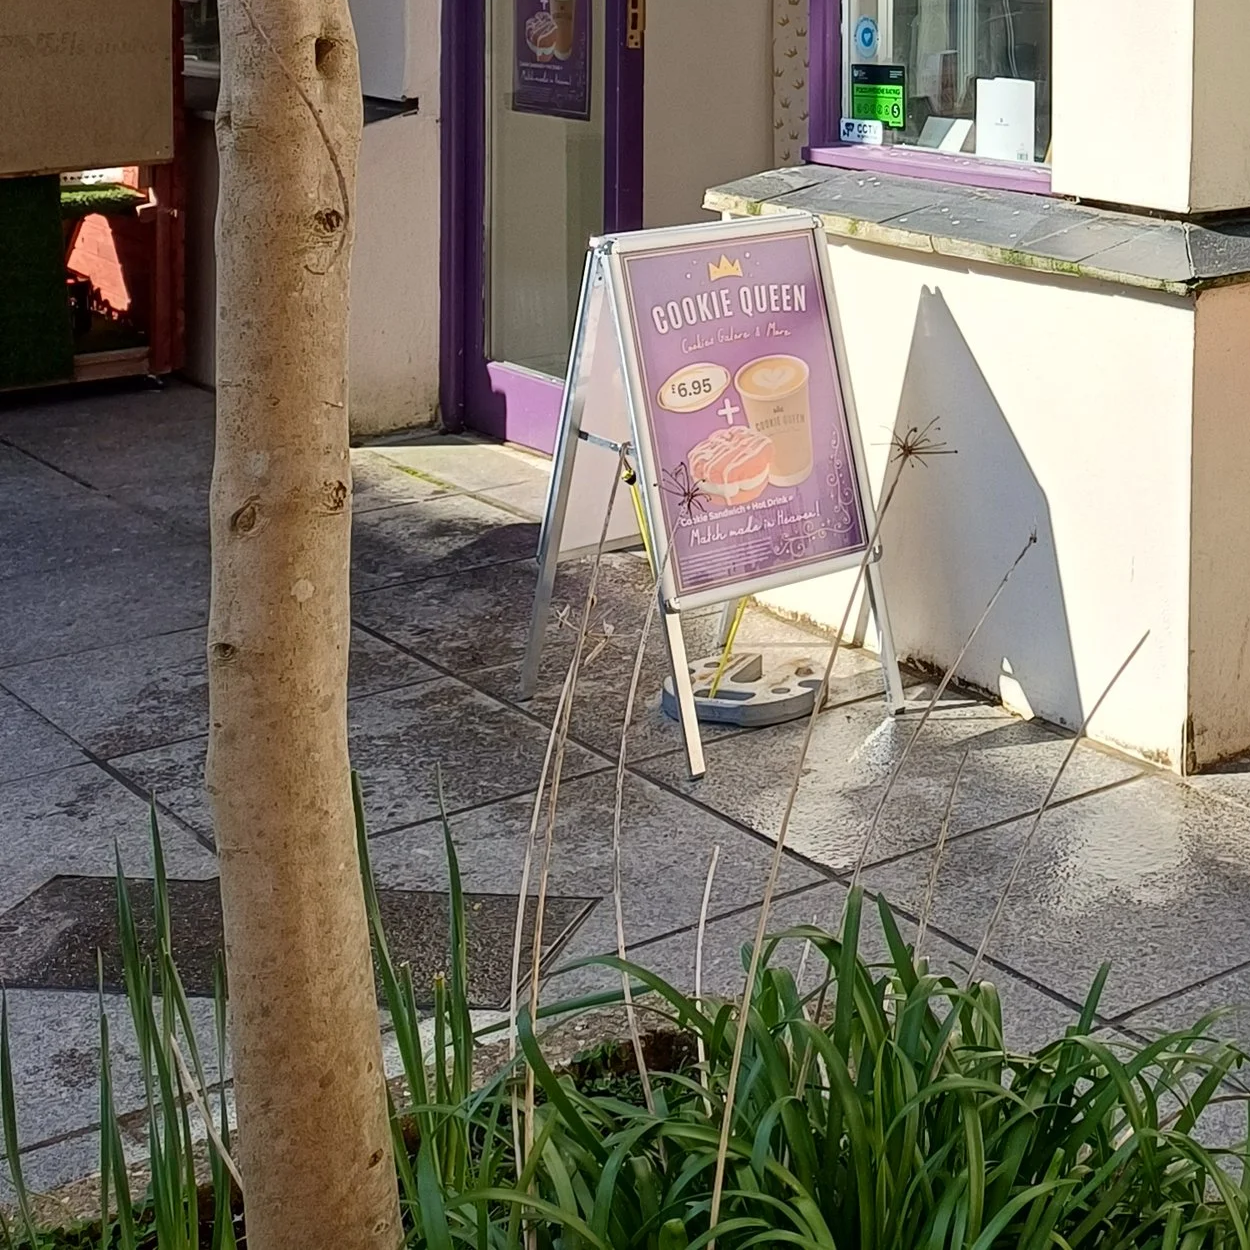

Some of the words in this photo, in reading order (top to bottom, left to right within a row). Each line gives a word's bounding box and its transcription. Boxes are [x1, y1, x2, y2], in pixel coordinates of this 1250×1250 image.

[857, 123, 878, 135] CCTV
[652, 289, 734, 334] COOKIE
[739, 284, 806, 316] QUEEN
[682, 334, 714, 354] Cookies
[717, 326, 750, 343] Galore
[766, 321, 791, 337] More
[672, 378, 712, 398] £6.95
[708, 505, 746, 521] Sandwich
[767, 496, 788, 508] Drink
[690, 523, 728, 547] Match
[729, 516, 762, 536] made
[763, 519, 775, 529] in
